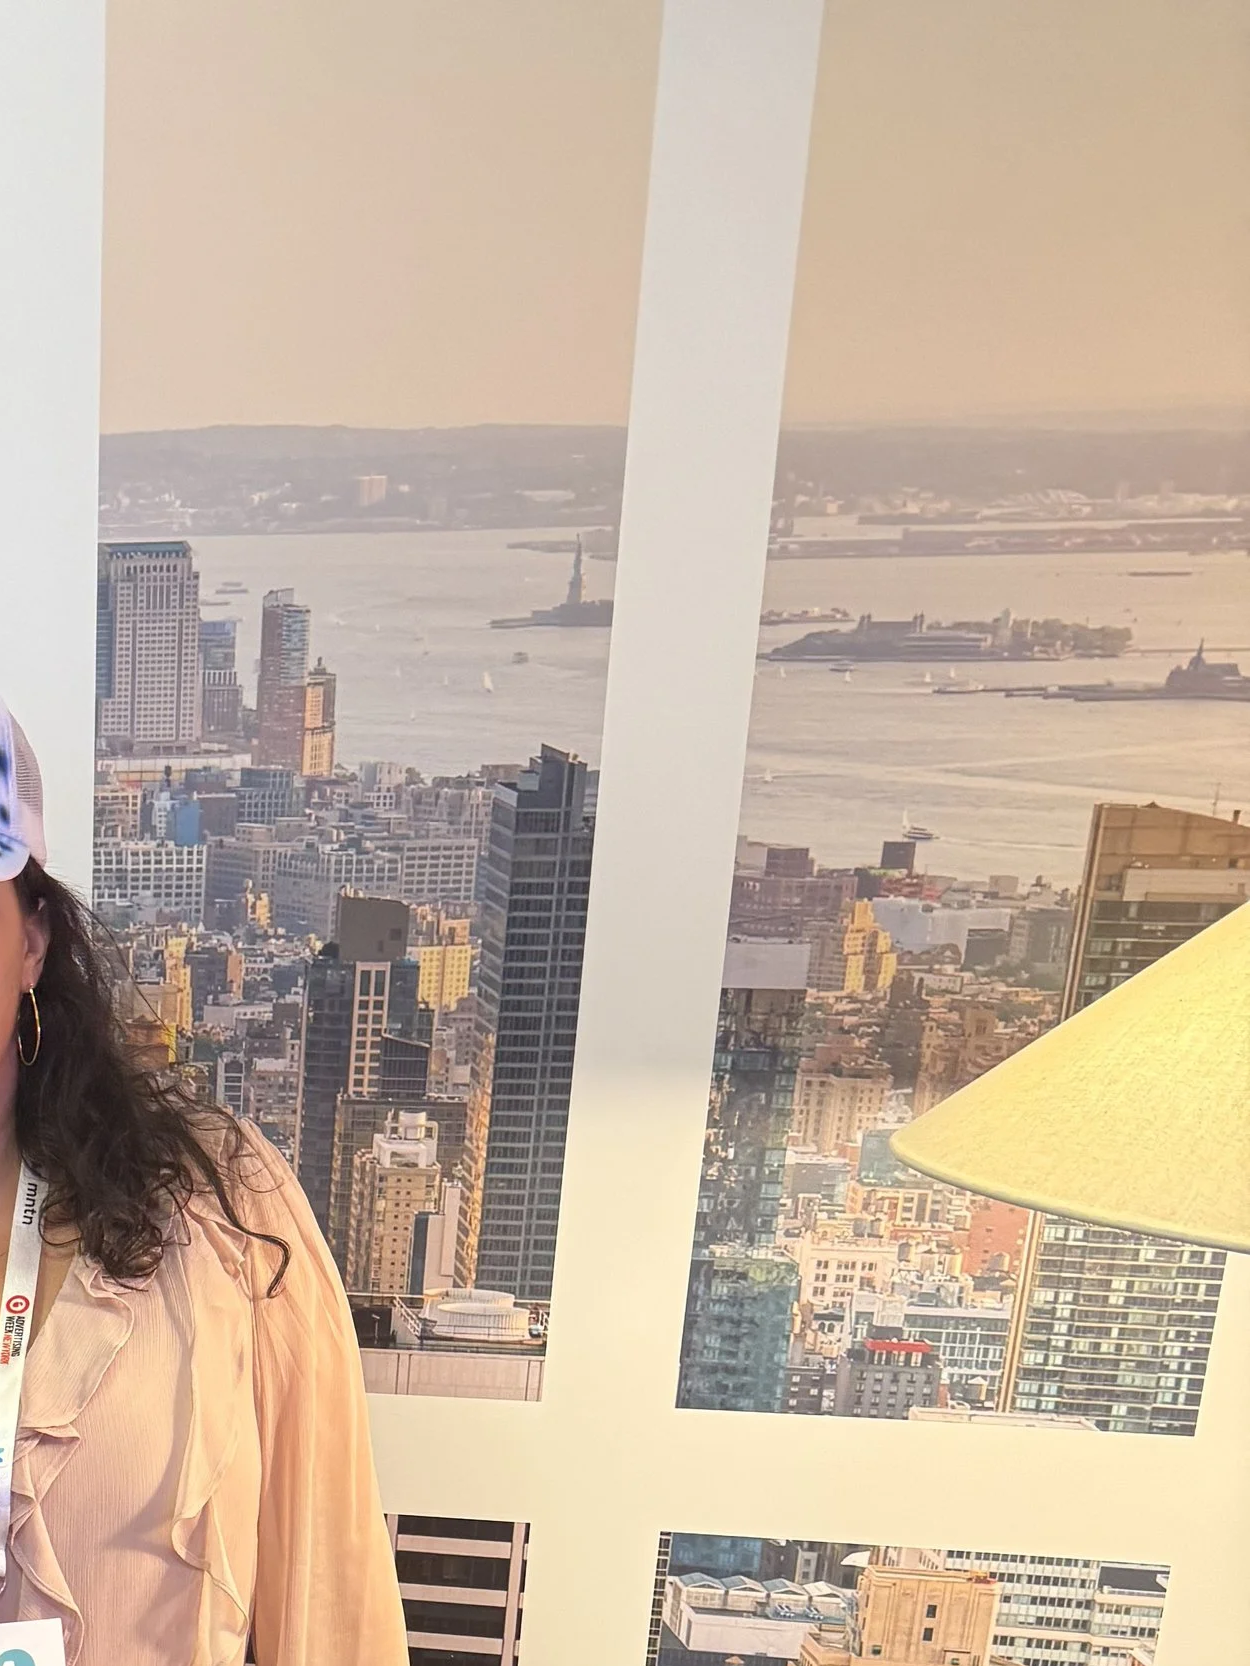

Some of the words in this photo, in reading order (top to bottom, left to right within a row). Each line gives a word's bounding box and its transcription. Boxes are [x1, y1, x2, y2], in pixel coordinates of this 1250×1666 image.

[21, 1182, 38, 1225] mntn
[4, 1315, 15, 1334] WEEK
[11, 1315, 25, 1358] ADVERTISING
